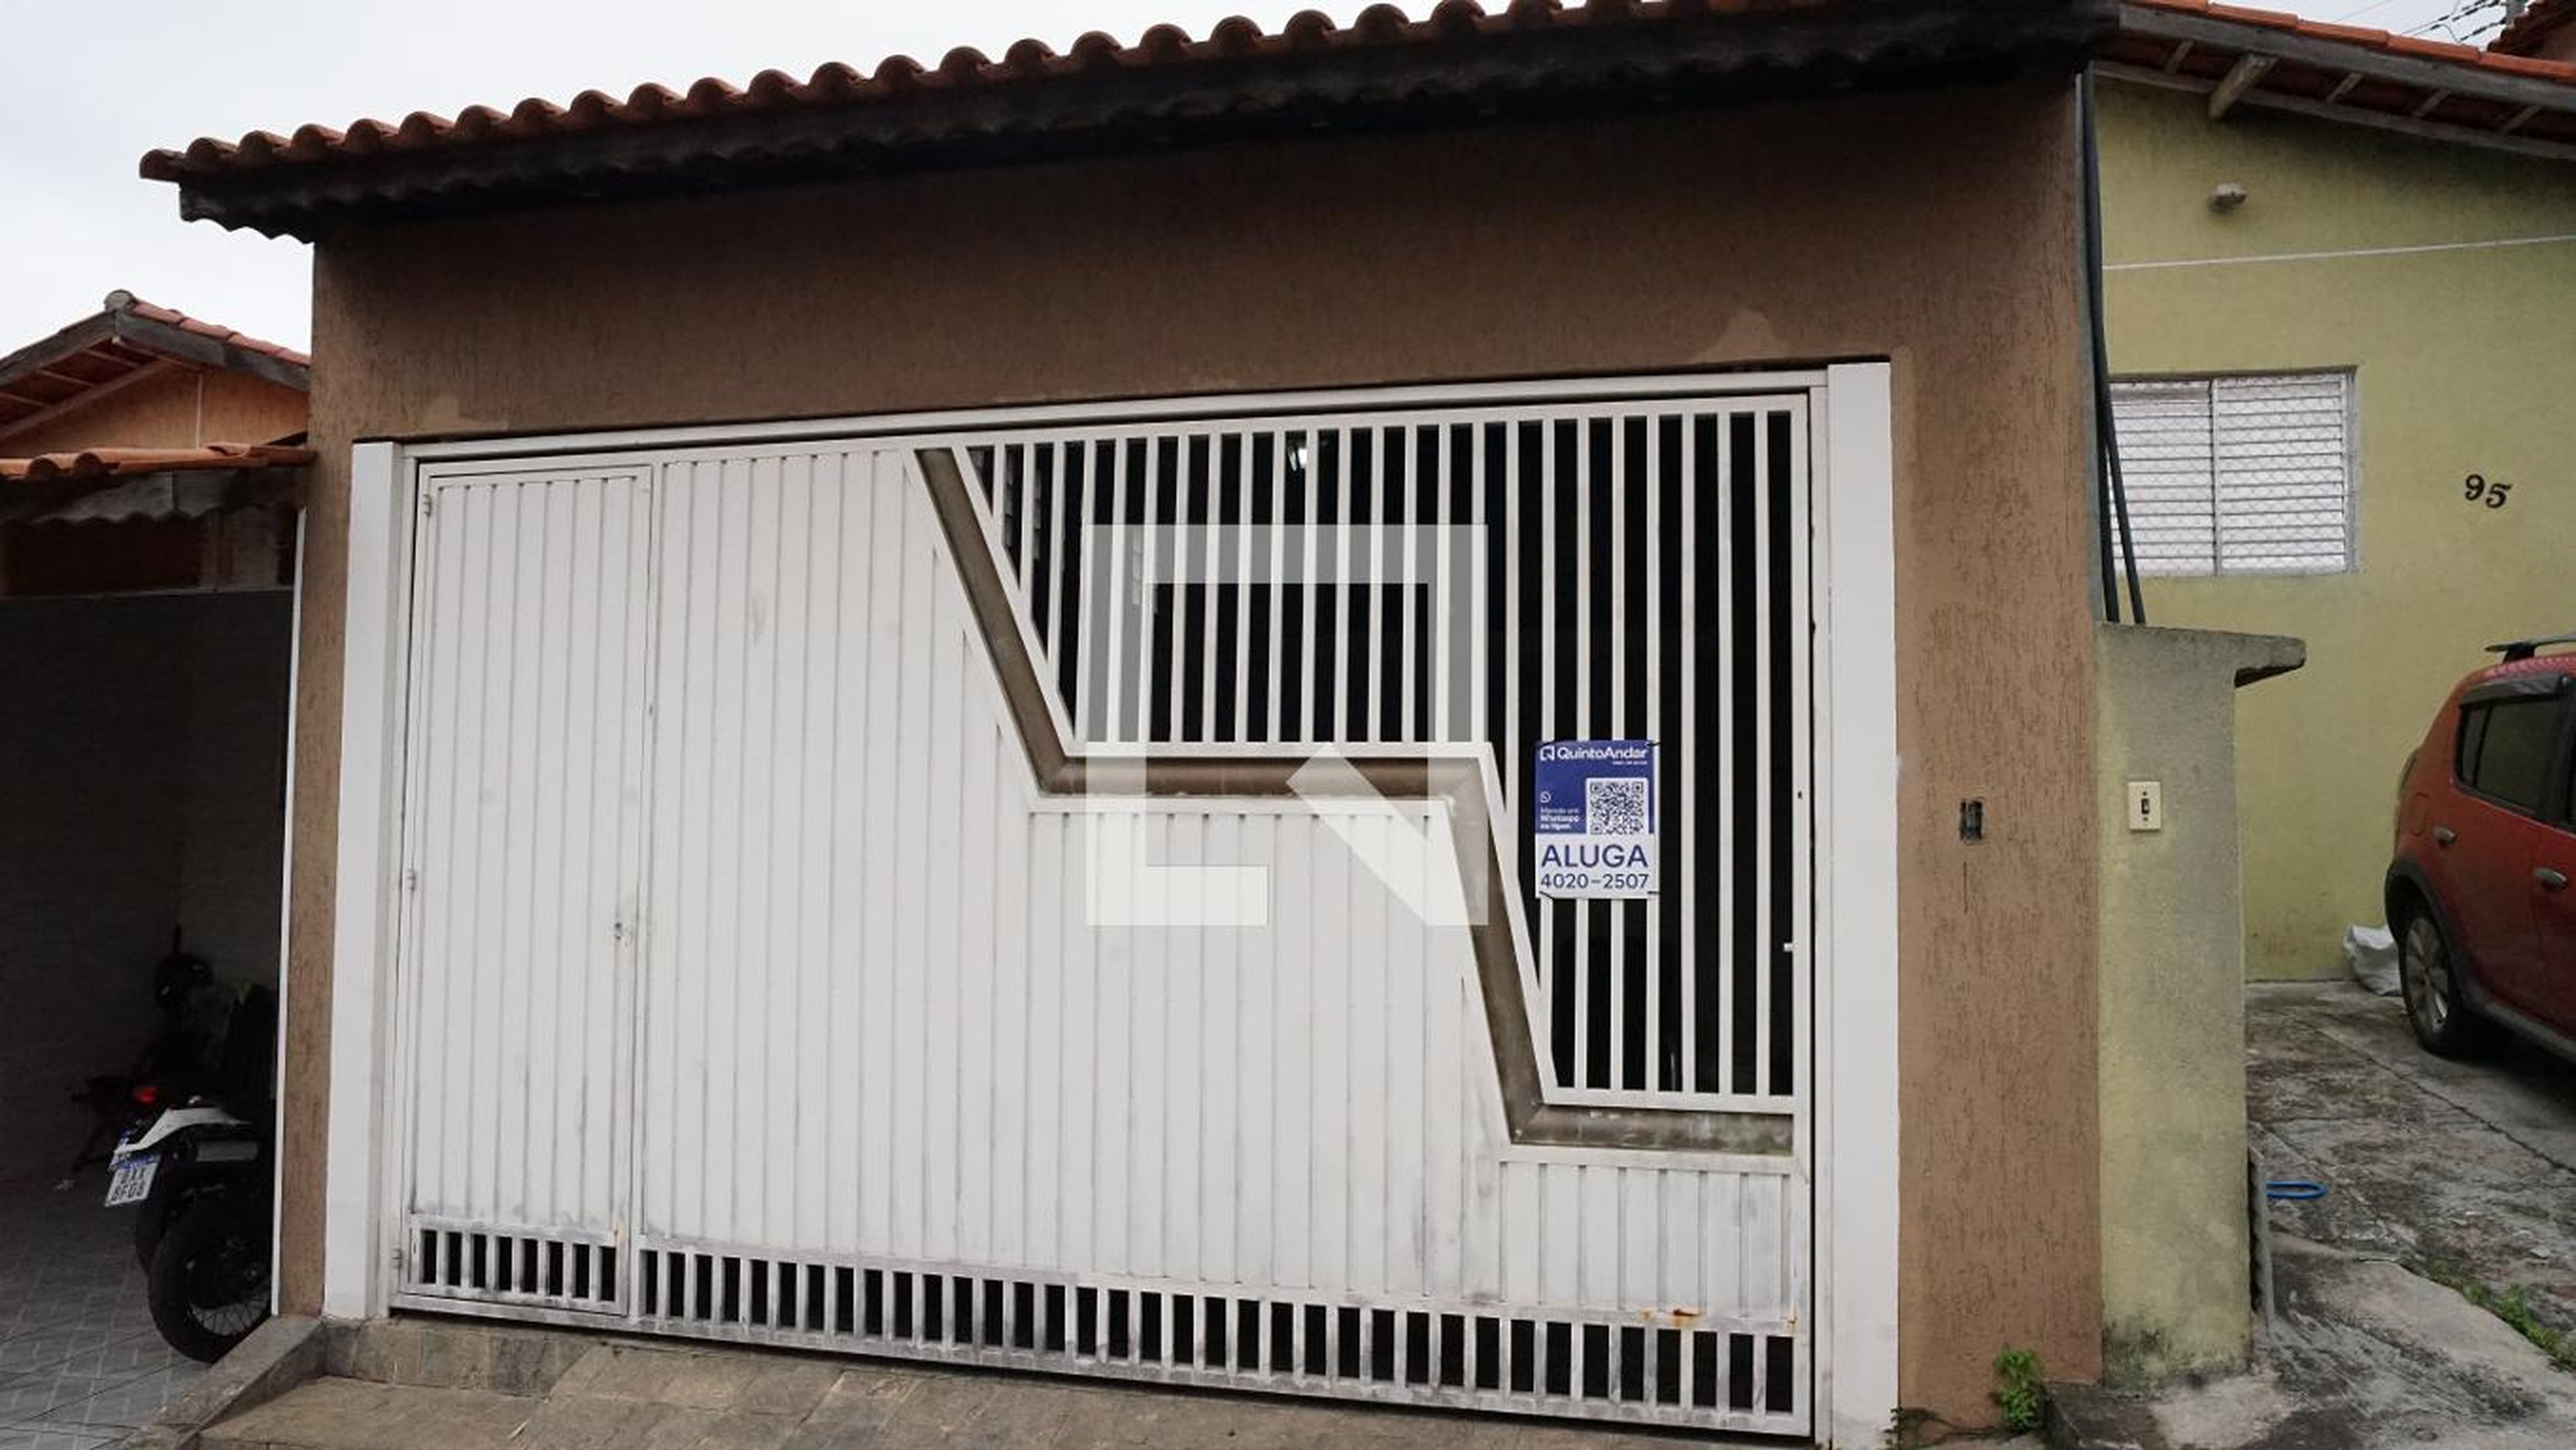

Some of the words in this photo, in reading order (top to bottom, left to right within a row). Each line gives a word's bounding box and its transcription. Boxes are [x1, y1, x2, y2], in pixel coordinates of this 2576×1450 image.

[2465, 473, 2512, 509] 95
[1556, 746, 1647, 760] QuintoAndar
[1542, 844, 1648, 869] ALUGA
[1540, 873, 1649, 889] 4020-2507
